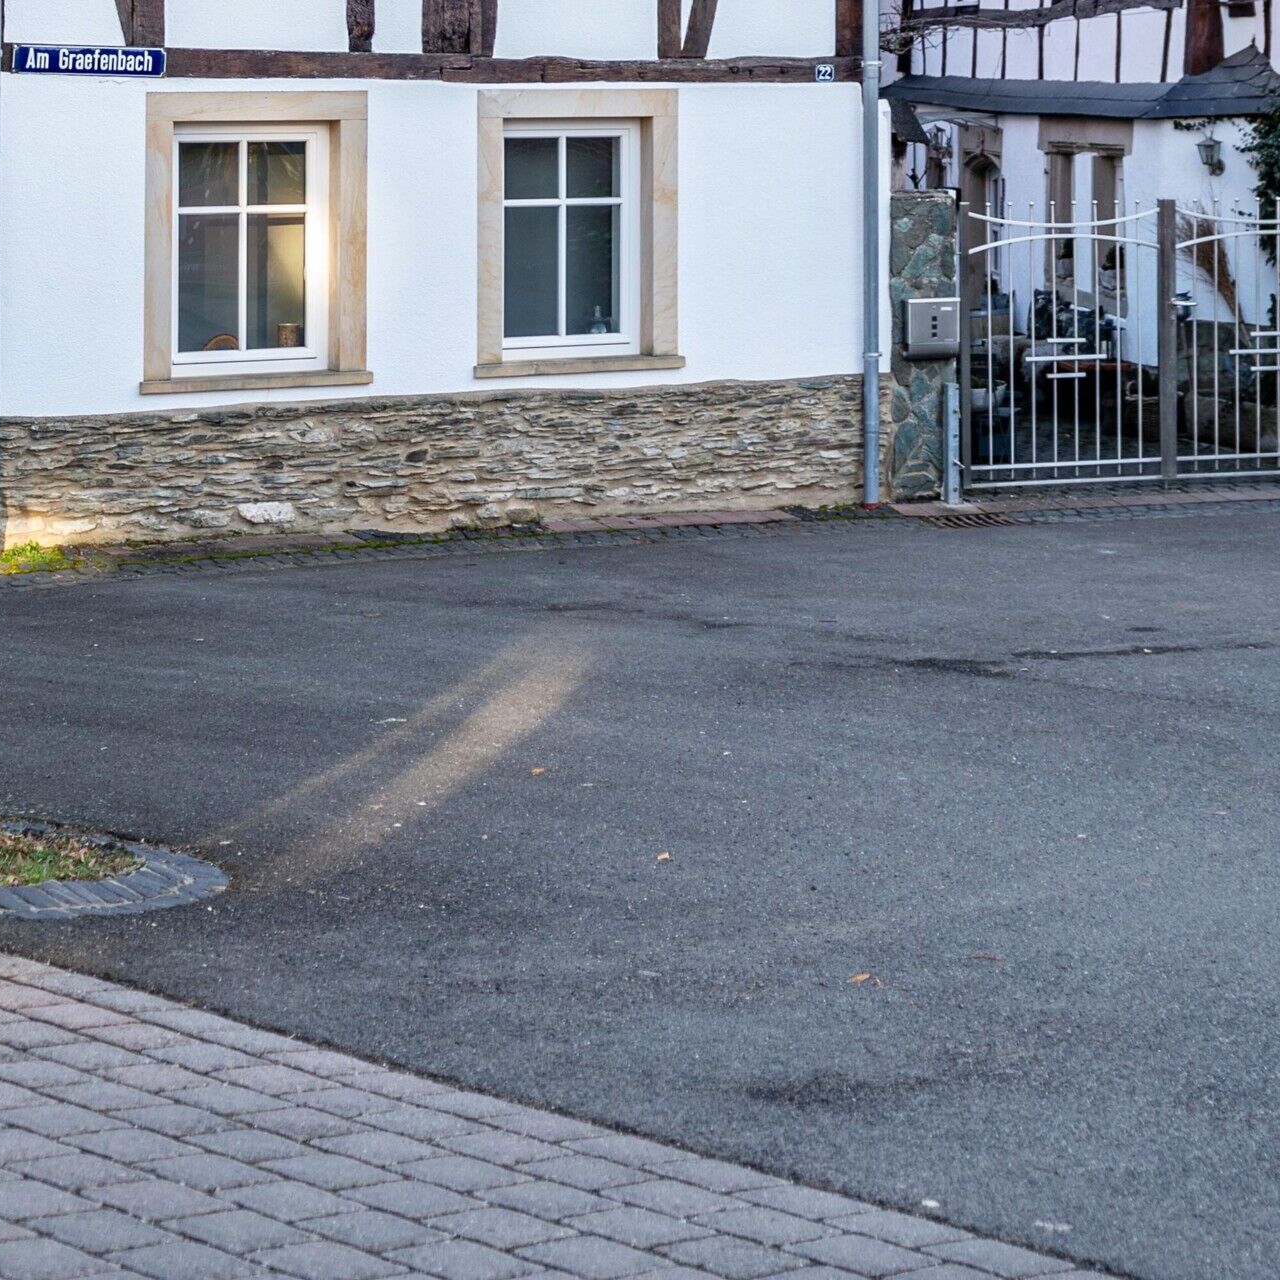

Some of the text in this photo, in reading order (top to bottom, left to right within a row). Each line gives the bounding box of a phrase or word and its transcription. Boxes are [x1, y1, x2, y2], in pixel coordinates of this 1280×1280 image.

[25, 47, 154, 72] Am Graefenbach
[818, 66, 832, 80] 22
